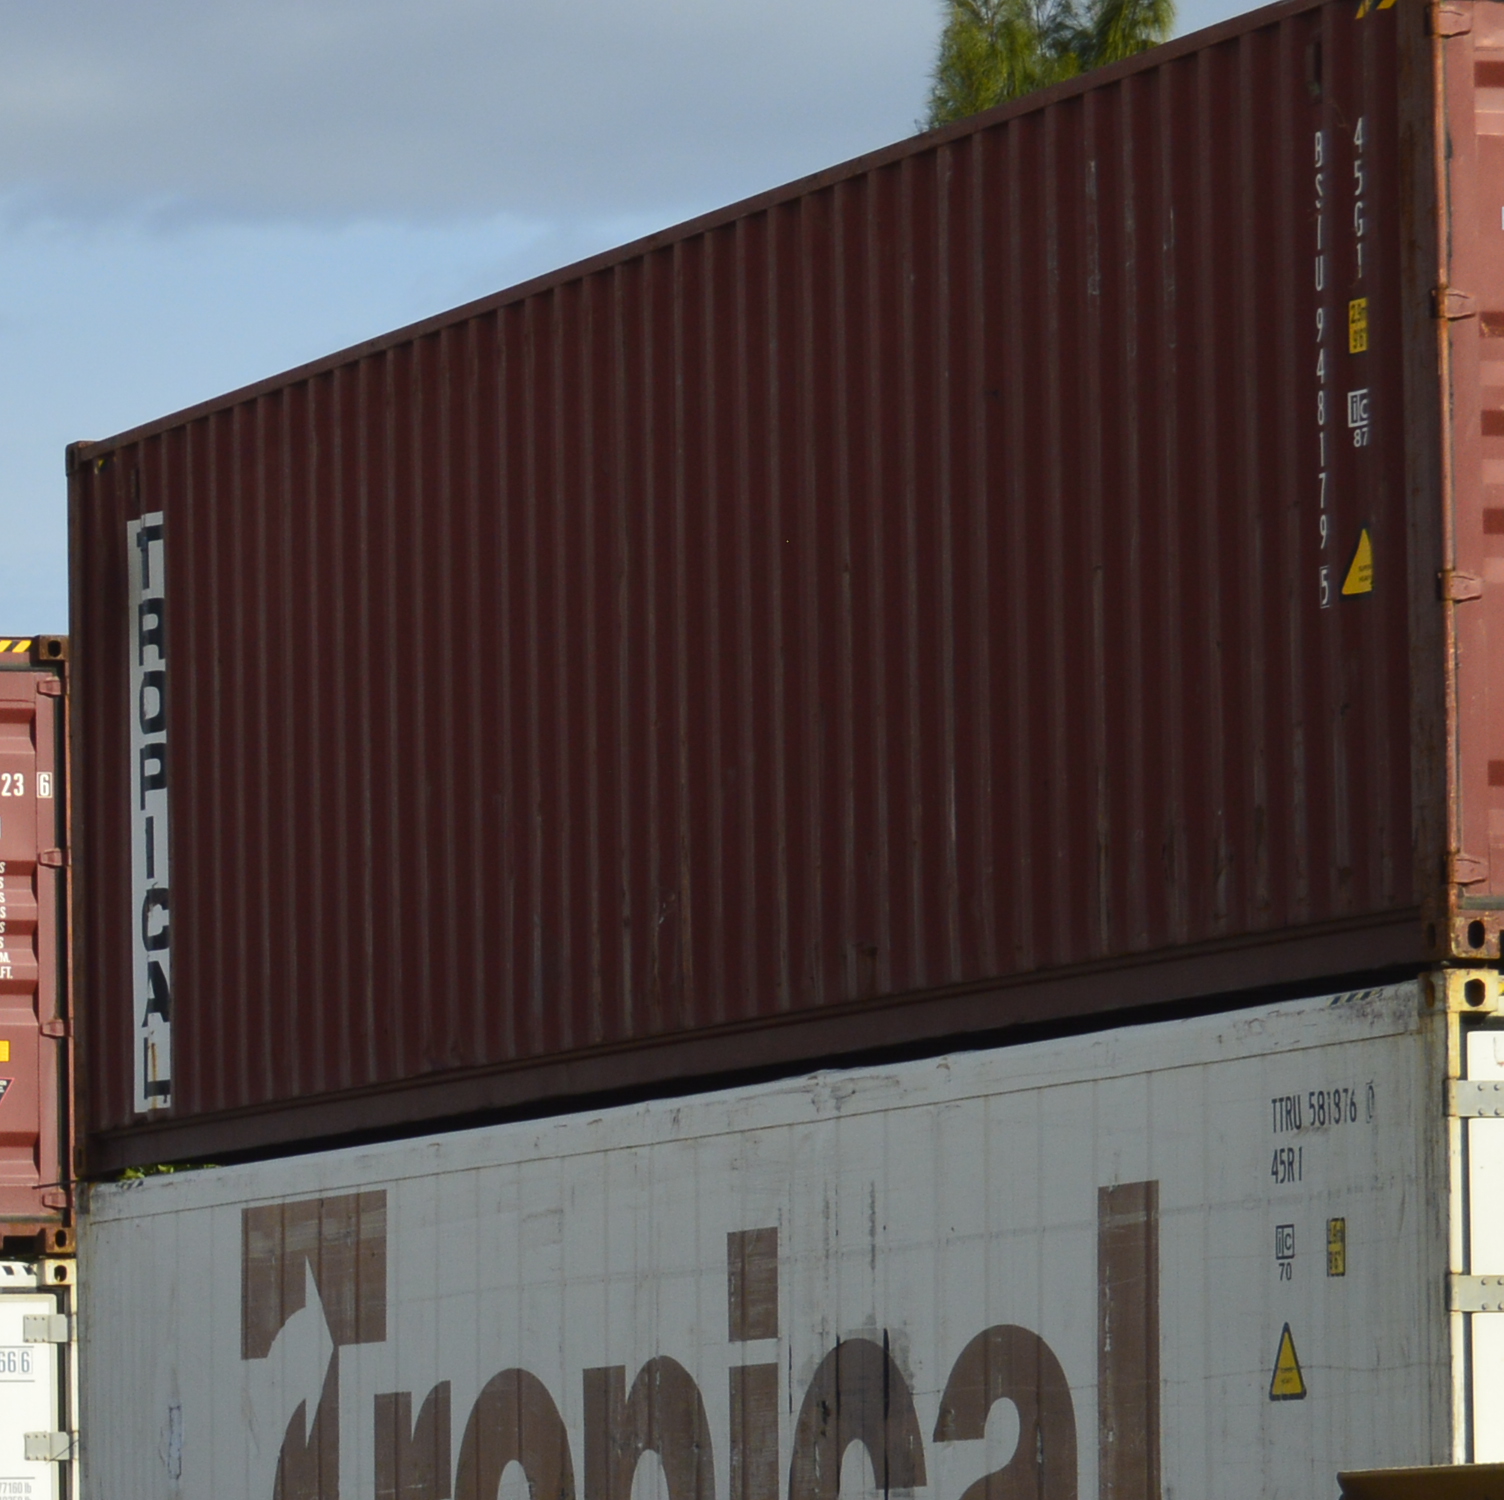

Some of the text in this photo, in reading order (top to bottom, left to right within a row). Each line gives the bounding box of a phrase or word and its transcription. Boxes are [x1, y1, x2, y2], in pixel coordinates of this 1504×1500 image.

[1353, 428, 1368, 448] 87
[38, 773, 51, 797] 6
[136, 522, 171, 1104] TROPICAL
[1271, 1094, 1303, 1134] TTRU
[1271, 1146, 1303, 1185] 45R1
[1278, 1262, 1292, 1282] 70
[24, 1482, 32, 1494] lb
